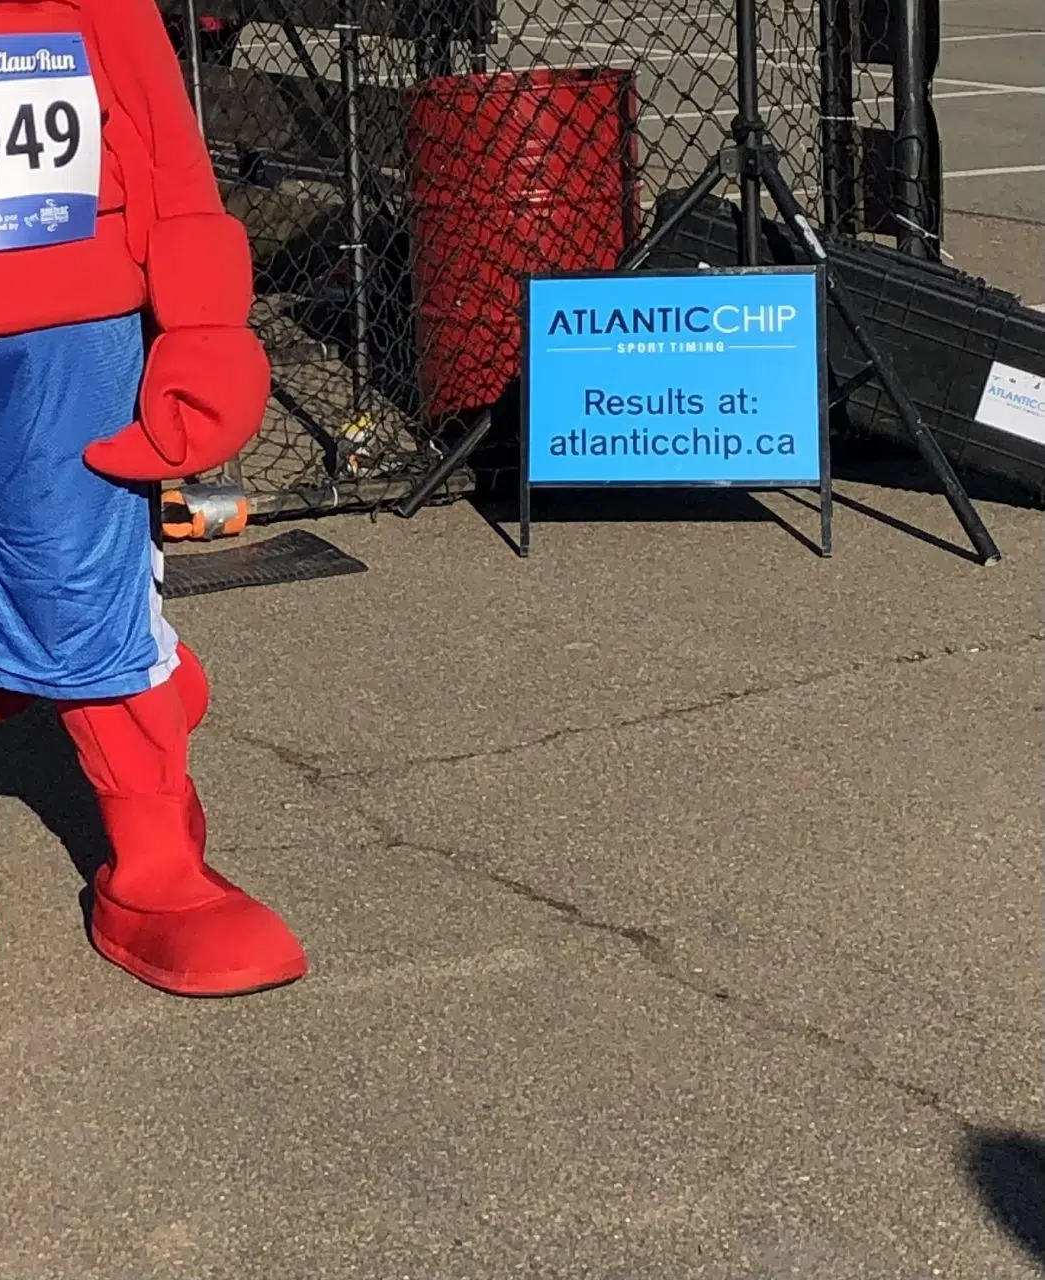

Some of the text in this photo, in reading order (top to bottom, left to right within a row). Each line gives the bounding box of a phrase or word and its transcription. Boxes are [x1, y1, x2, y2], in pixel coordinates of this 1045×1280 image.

[35, 48, 77, 71] Run
[547, 304, 797, 336] ATLANTICCHIP
[617, 341, 725, 354] SPORT TIMING
[584, 387, 759, 416] Results at:
[548, 427, 796, 460] atlanticchip.ca
